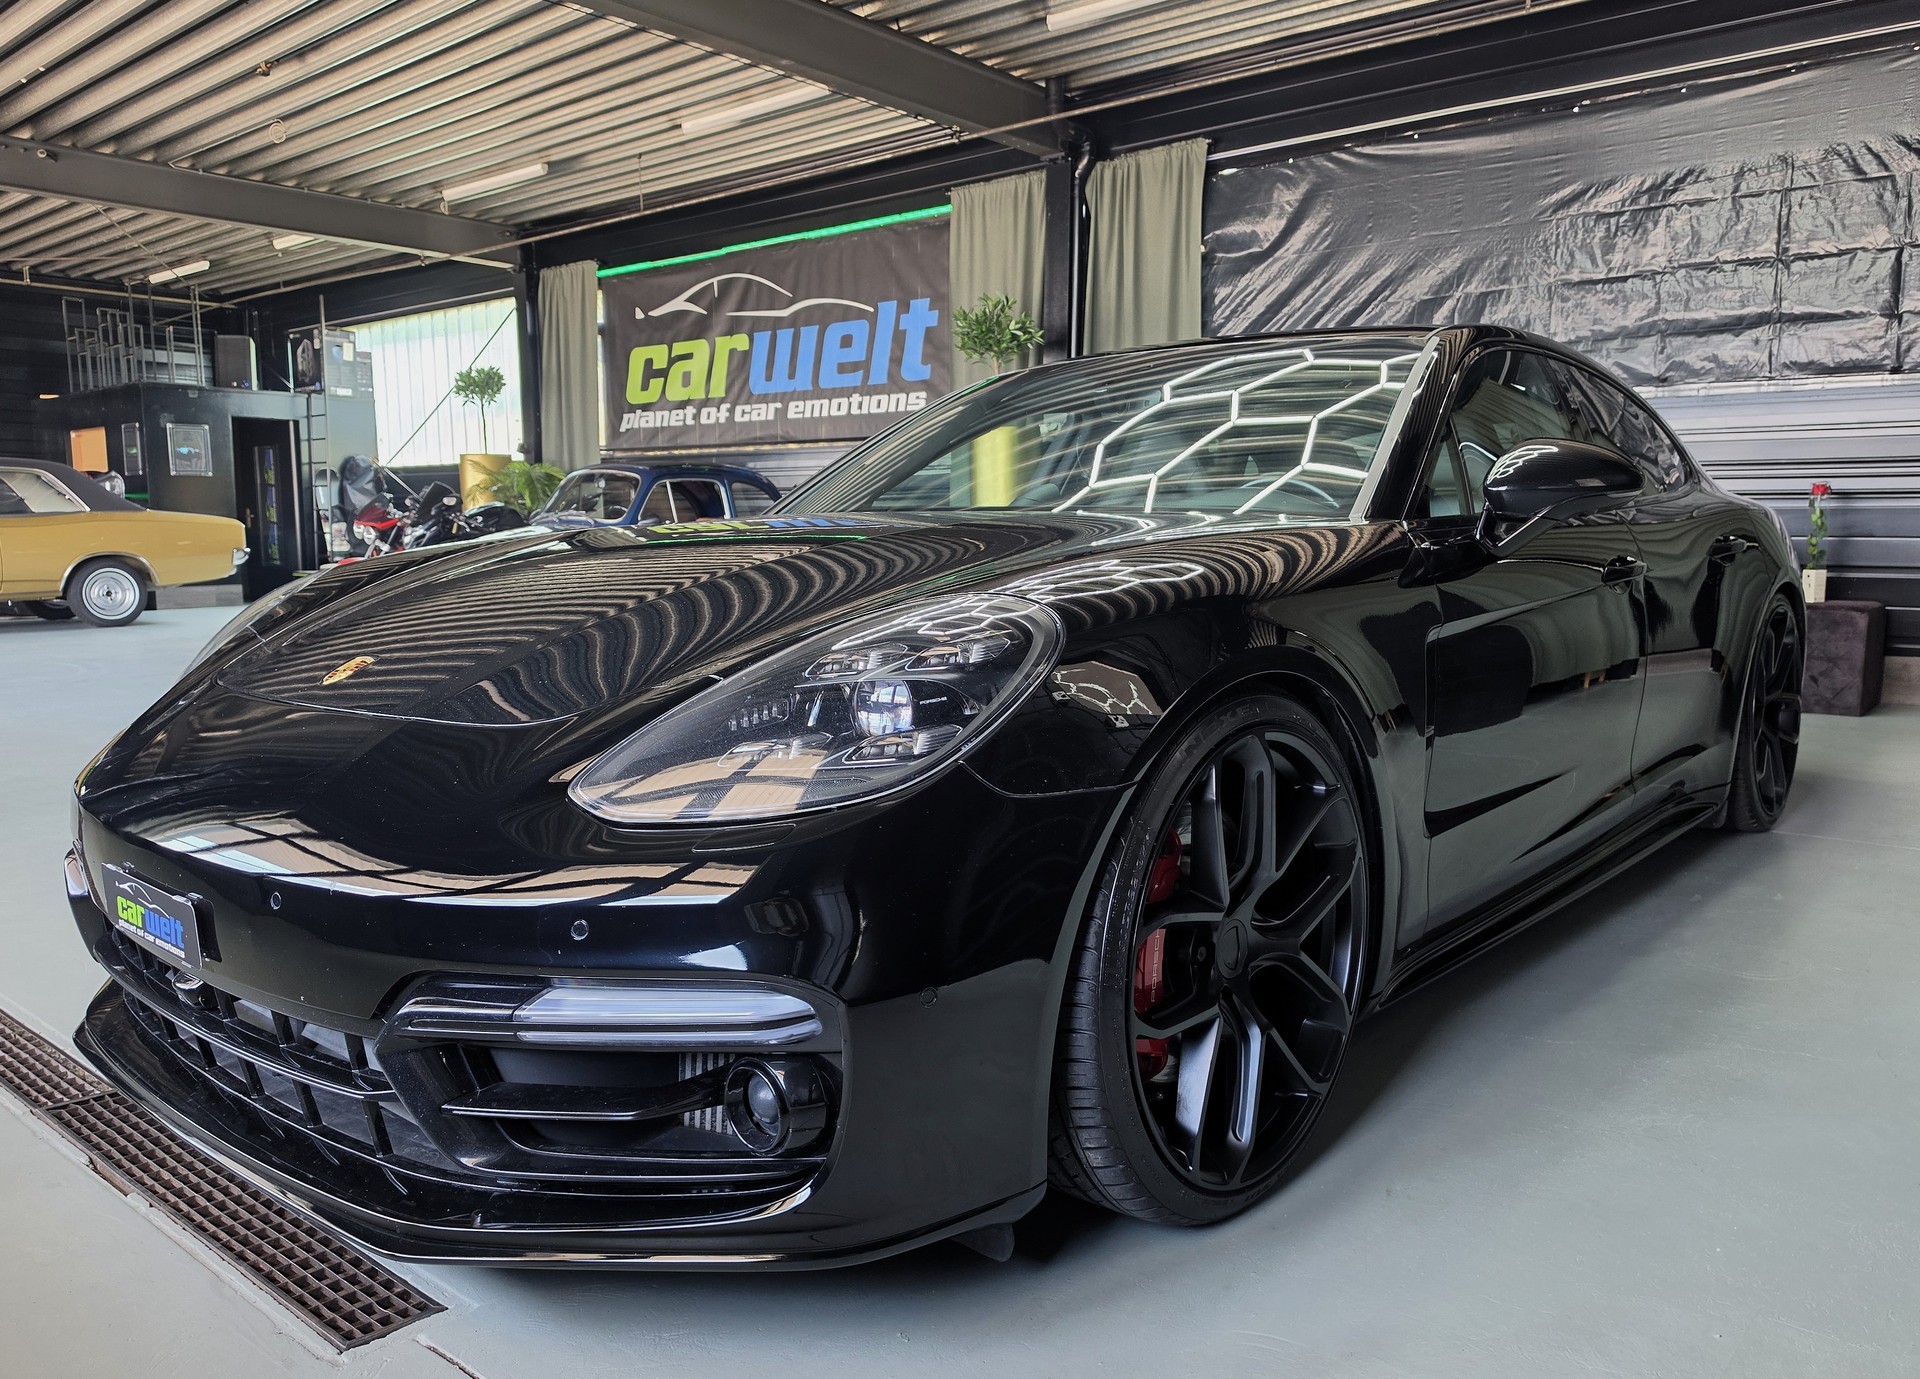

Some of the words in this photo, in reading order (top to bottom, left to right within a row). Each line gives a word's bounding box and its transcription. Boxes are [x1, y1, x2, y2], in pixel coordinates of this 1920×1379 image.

[625, 297, 939, 405] carwelt
[619, 404, 697, 433] planet
[700, 402, 731, 425] of
[734, 401, 783, 423] car
[787, 391, 928, 419] emotions
[117, 895, 185, 948] carwelt
[1150, 928, 1160, 1003] PORSCH
